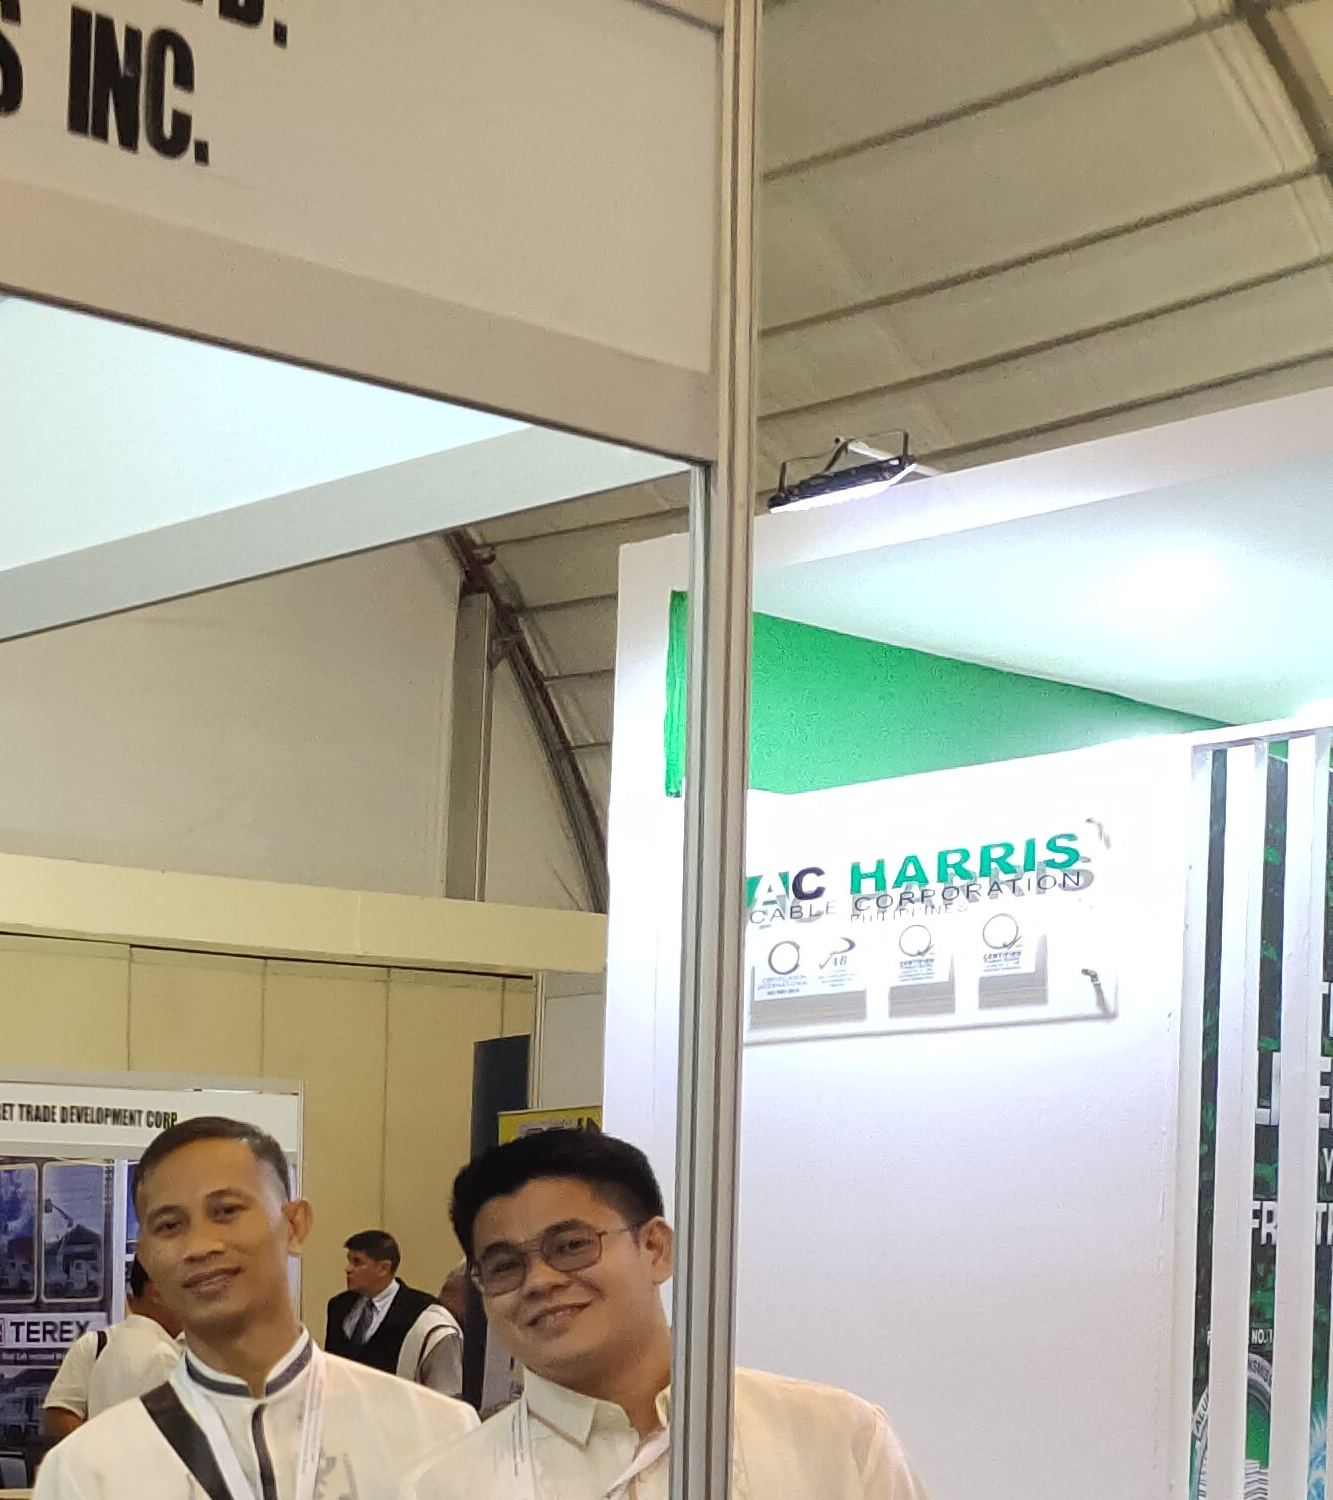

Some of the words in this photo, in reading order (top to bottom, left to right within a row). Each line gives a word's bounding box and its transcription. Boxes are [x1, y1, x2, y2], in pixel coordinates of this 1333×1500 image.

[67, 4, 210, 166] INC.
[849, 833, 1082, 895] HARRIS
[749, 901, 838, 924] CABLE
[854, 871, 1082, 913] CORPORATION
[18, 1103, 57, 1124] TRADE
[60, 1105, 144, 1128] DEVELOPMENT
[9, 1320, 90, 1343] TEREX
